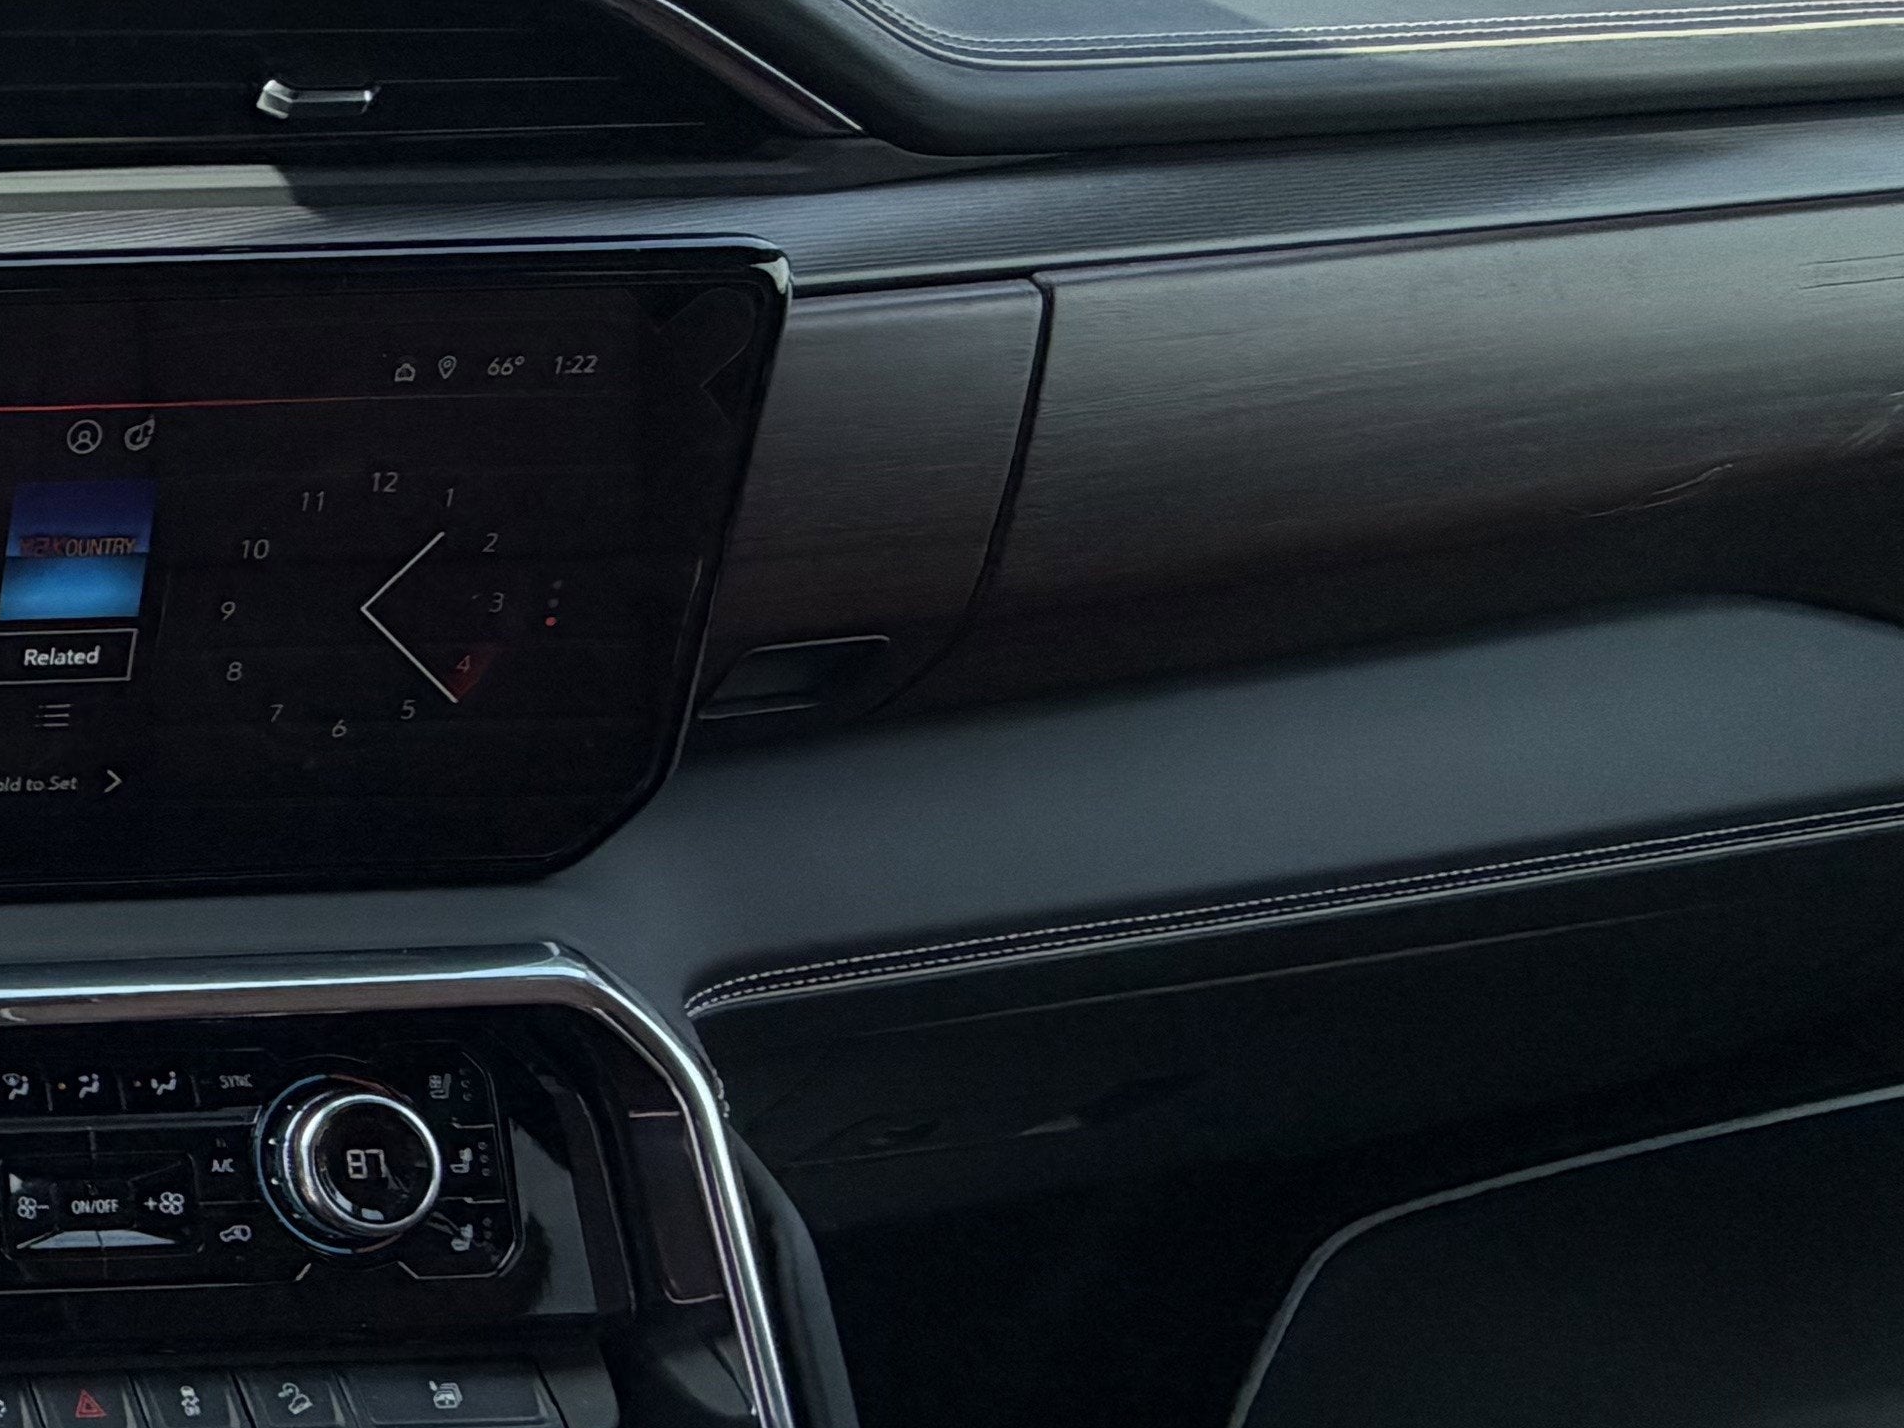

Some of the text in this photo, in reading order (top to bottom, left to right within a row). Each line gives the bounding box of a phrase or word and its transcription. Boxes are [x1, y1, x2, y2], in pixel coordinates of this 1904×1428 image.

[553, 355, 599, 375] 1:22
[371, 471, 398, 493] 12
[301, 491, 325, 512] 11
[444, 488, 454, 508] 1
[241, 538, 270, 560] 10
[482, 532, 499, 553] 2
[220, 601, 236, 621] 9
[488, 592, 504, 613] 3
[23, 644, 101, 667] Related
[226, 661, 243, 682] 8
[269, 703, 284, 723] 7
[400, 699, 416, 720] 5
[331, 719, 347, 738] 6
[26, 776, 45, 792] to
[49, 775, 78, 791] Set
[219, 1074, 253, 1089] SYNC
[71, 1198, 120, 1215] ON/OFF
